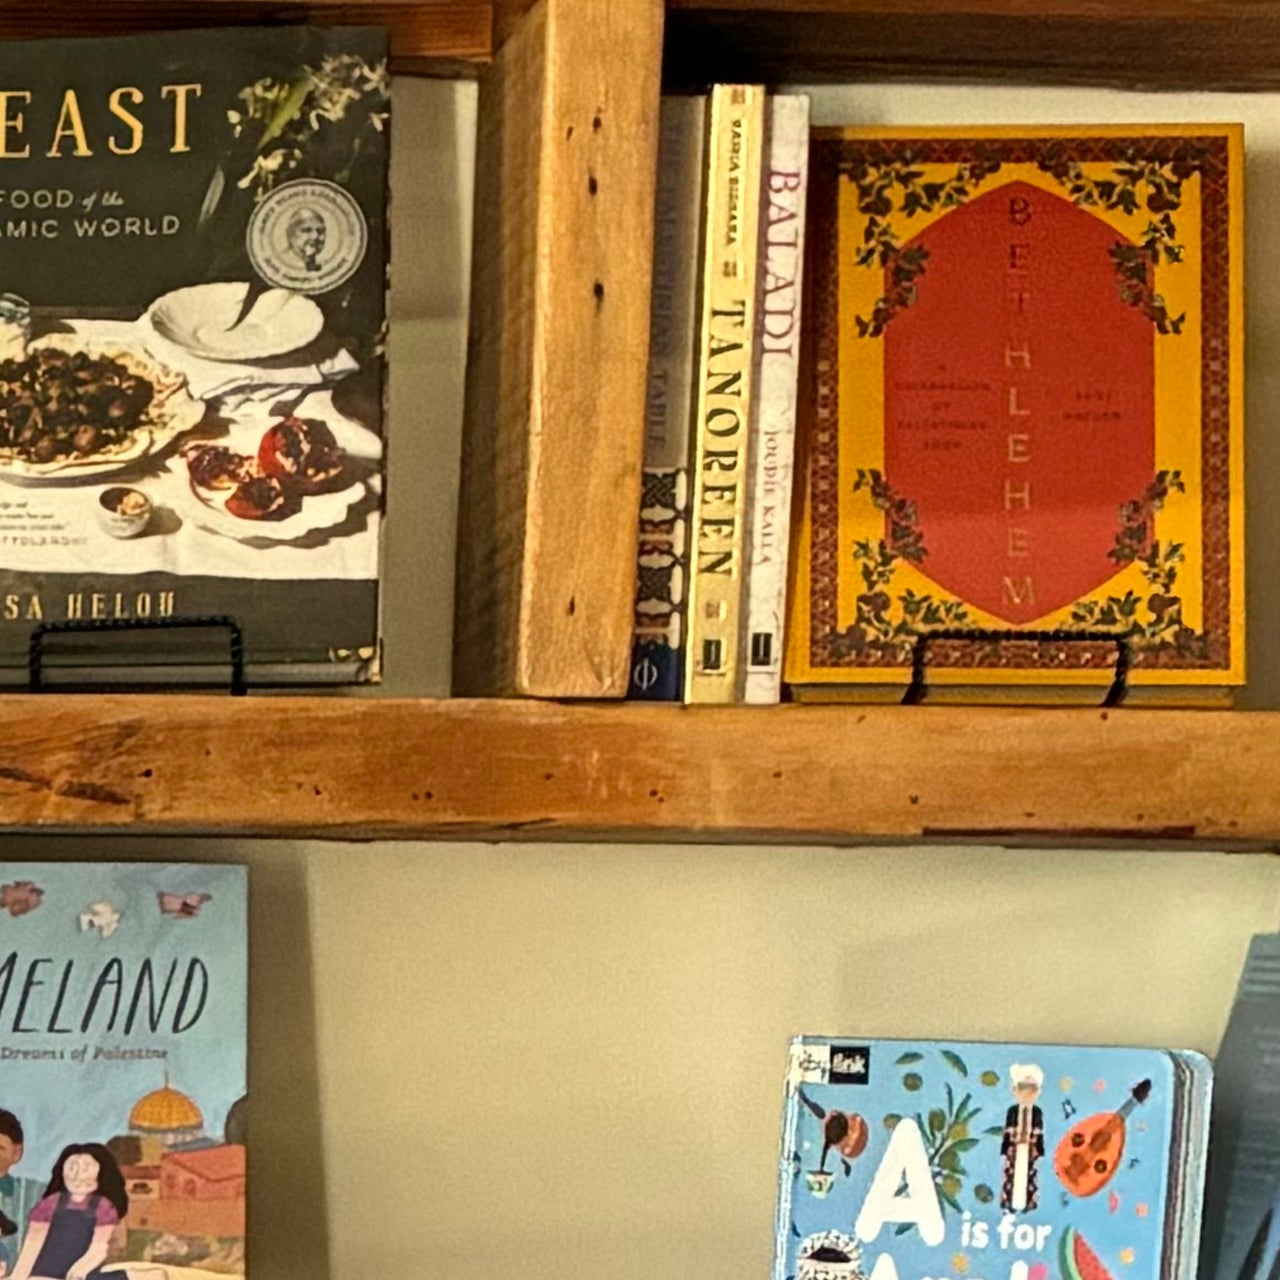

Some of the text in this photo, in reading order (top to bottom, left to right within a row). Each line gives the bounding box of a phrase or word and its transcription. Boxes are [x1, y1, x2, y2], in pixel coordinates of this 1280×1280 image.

[74, 215, 181, 238] WORLD
[81, 190, 99, 213] of
[101, 190, 124, 207] the
[761, 170, 801, 359] BALADI
[698, 299, 746, 577] TANOREEN
[1003, 198, 1036, 608] BETHLEHEM
[66, 592, 175, 620] HELOU
[0, 1046, 65, 1061] Dreams
[70, 1045, 89, 1063] of
[92, 1046, 169, 1061] Palestine
[855, 1118, 1052, 1250] A is for
